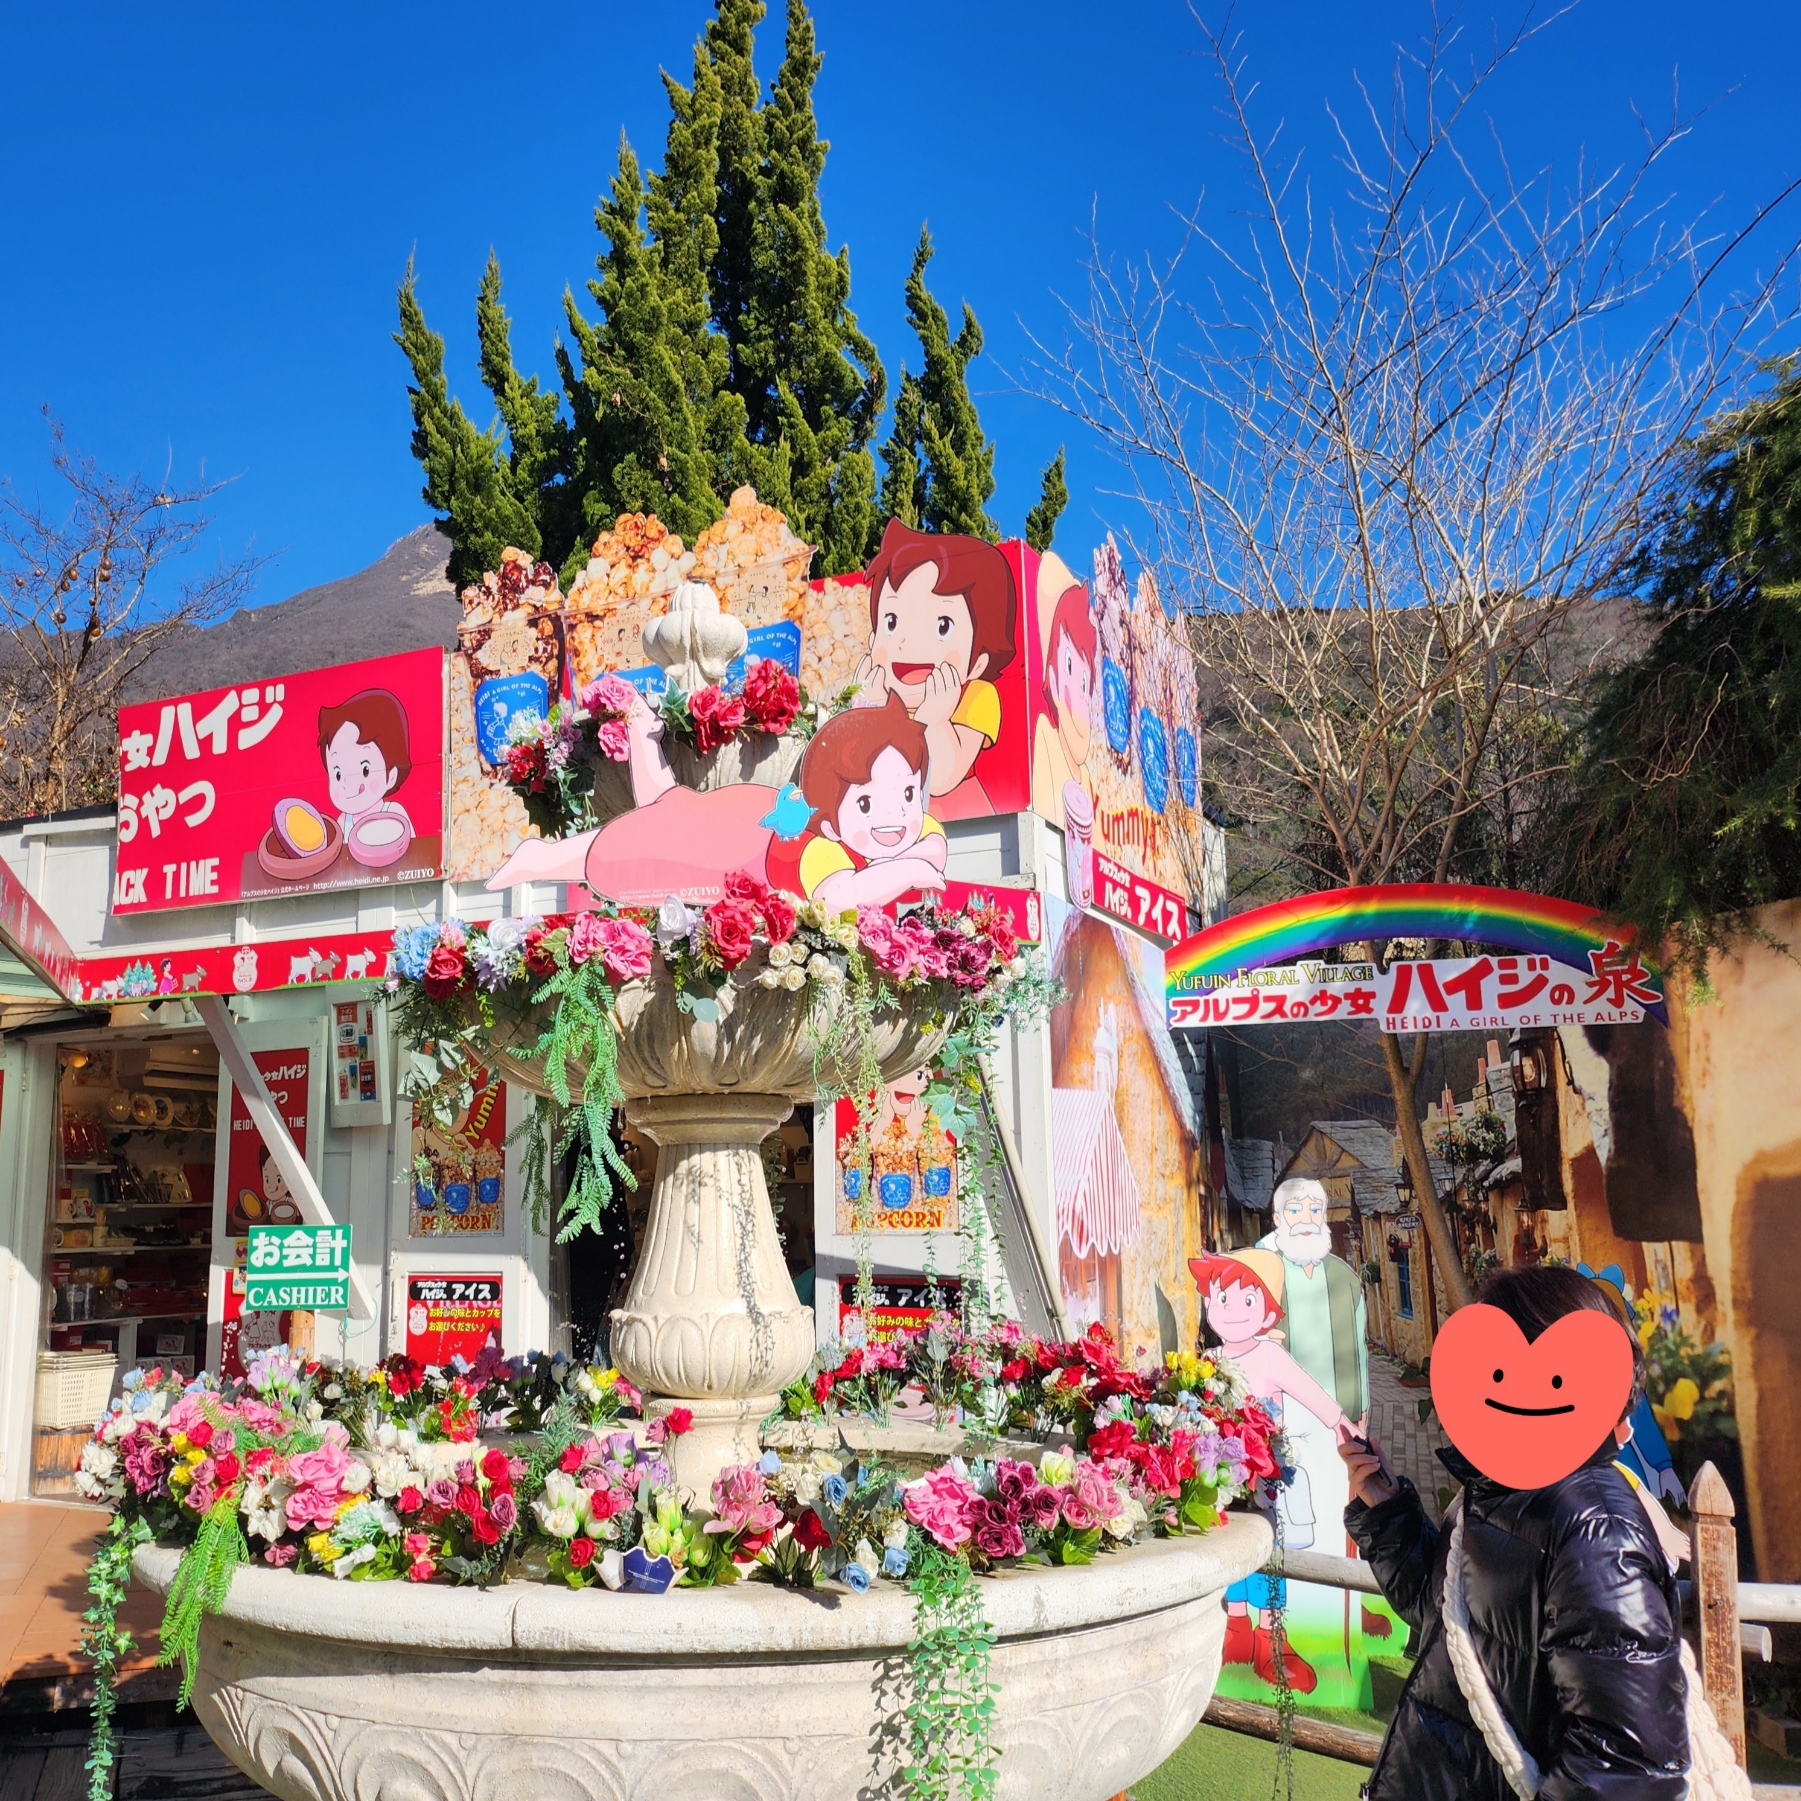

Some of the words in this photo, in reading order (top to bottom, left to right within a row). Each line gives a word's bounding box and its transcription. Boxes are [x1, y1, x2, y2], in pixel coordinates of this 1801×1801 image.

[120, 683, 285, 772] 女ハイジ
[162, 857, 220, 899] TIME
[313, 875, 389, 890] http://www.heidi.ne.jp
[1135, 885, 1181, 941] アイス
[1169, 970, 1232, 991] YUFUIN
[1236, 967, 1300, 988] FLORAL
[1300, 963, 1374, 984] VILLAGE
[1386, 941, 1663, 1015] ハイジの泉
[1172, 988, 1377, 1024] アルプスの少女
[1386, 1015, 1441, 1030] HEIDI
[1450, 1018, 1461, 1028] A
[1470, 1016, 1509, 1027] GIRL
[1519, 1014, 1542, 1025] OF
[1550, 1013, 1586, 1024] THE
[1594, 1011, 1641, 1023] ALPS
[233, 1119, 254, 1131] HEIDI
[288, 1116, 306, 1128] TIME
[250, 1229, 348, 1268] お会計
[248, 1286, 346, 1307] CASHIER
[451, 1282, 492, 1300] アイス
